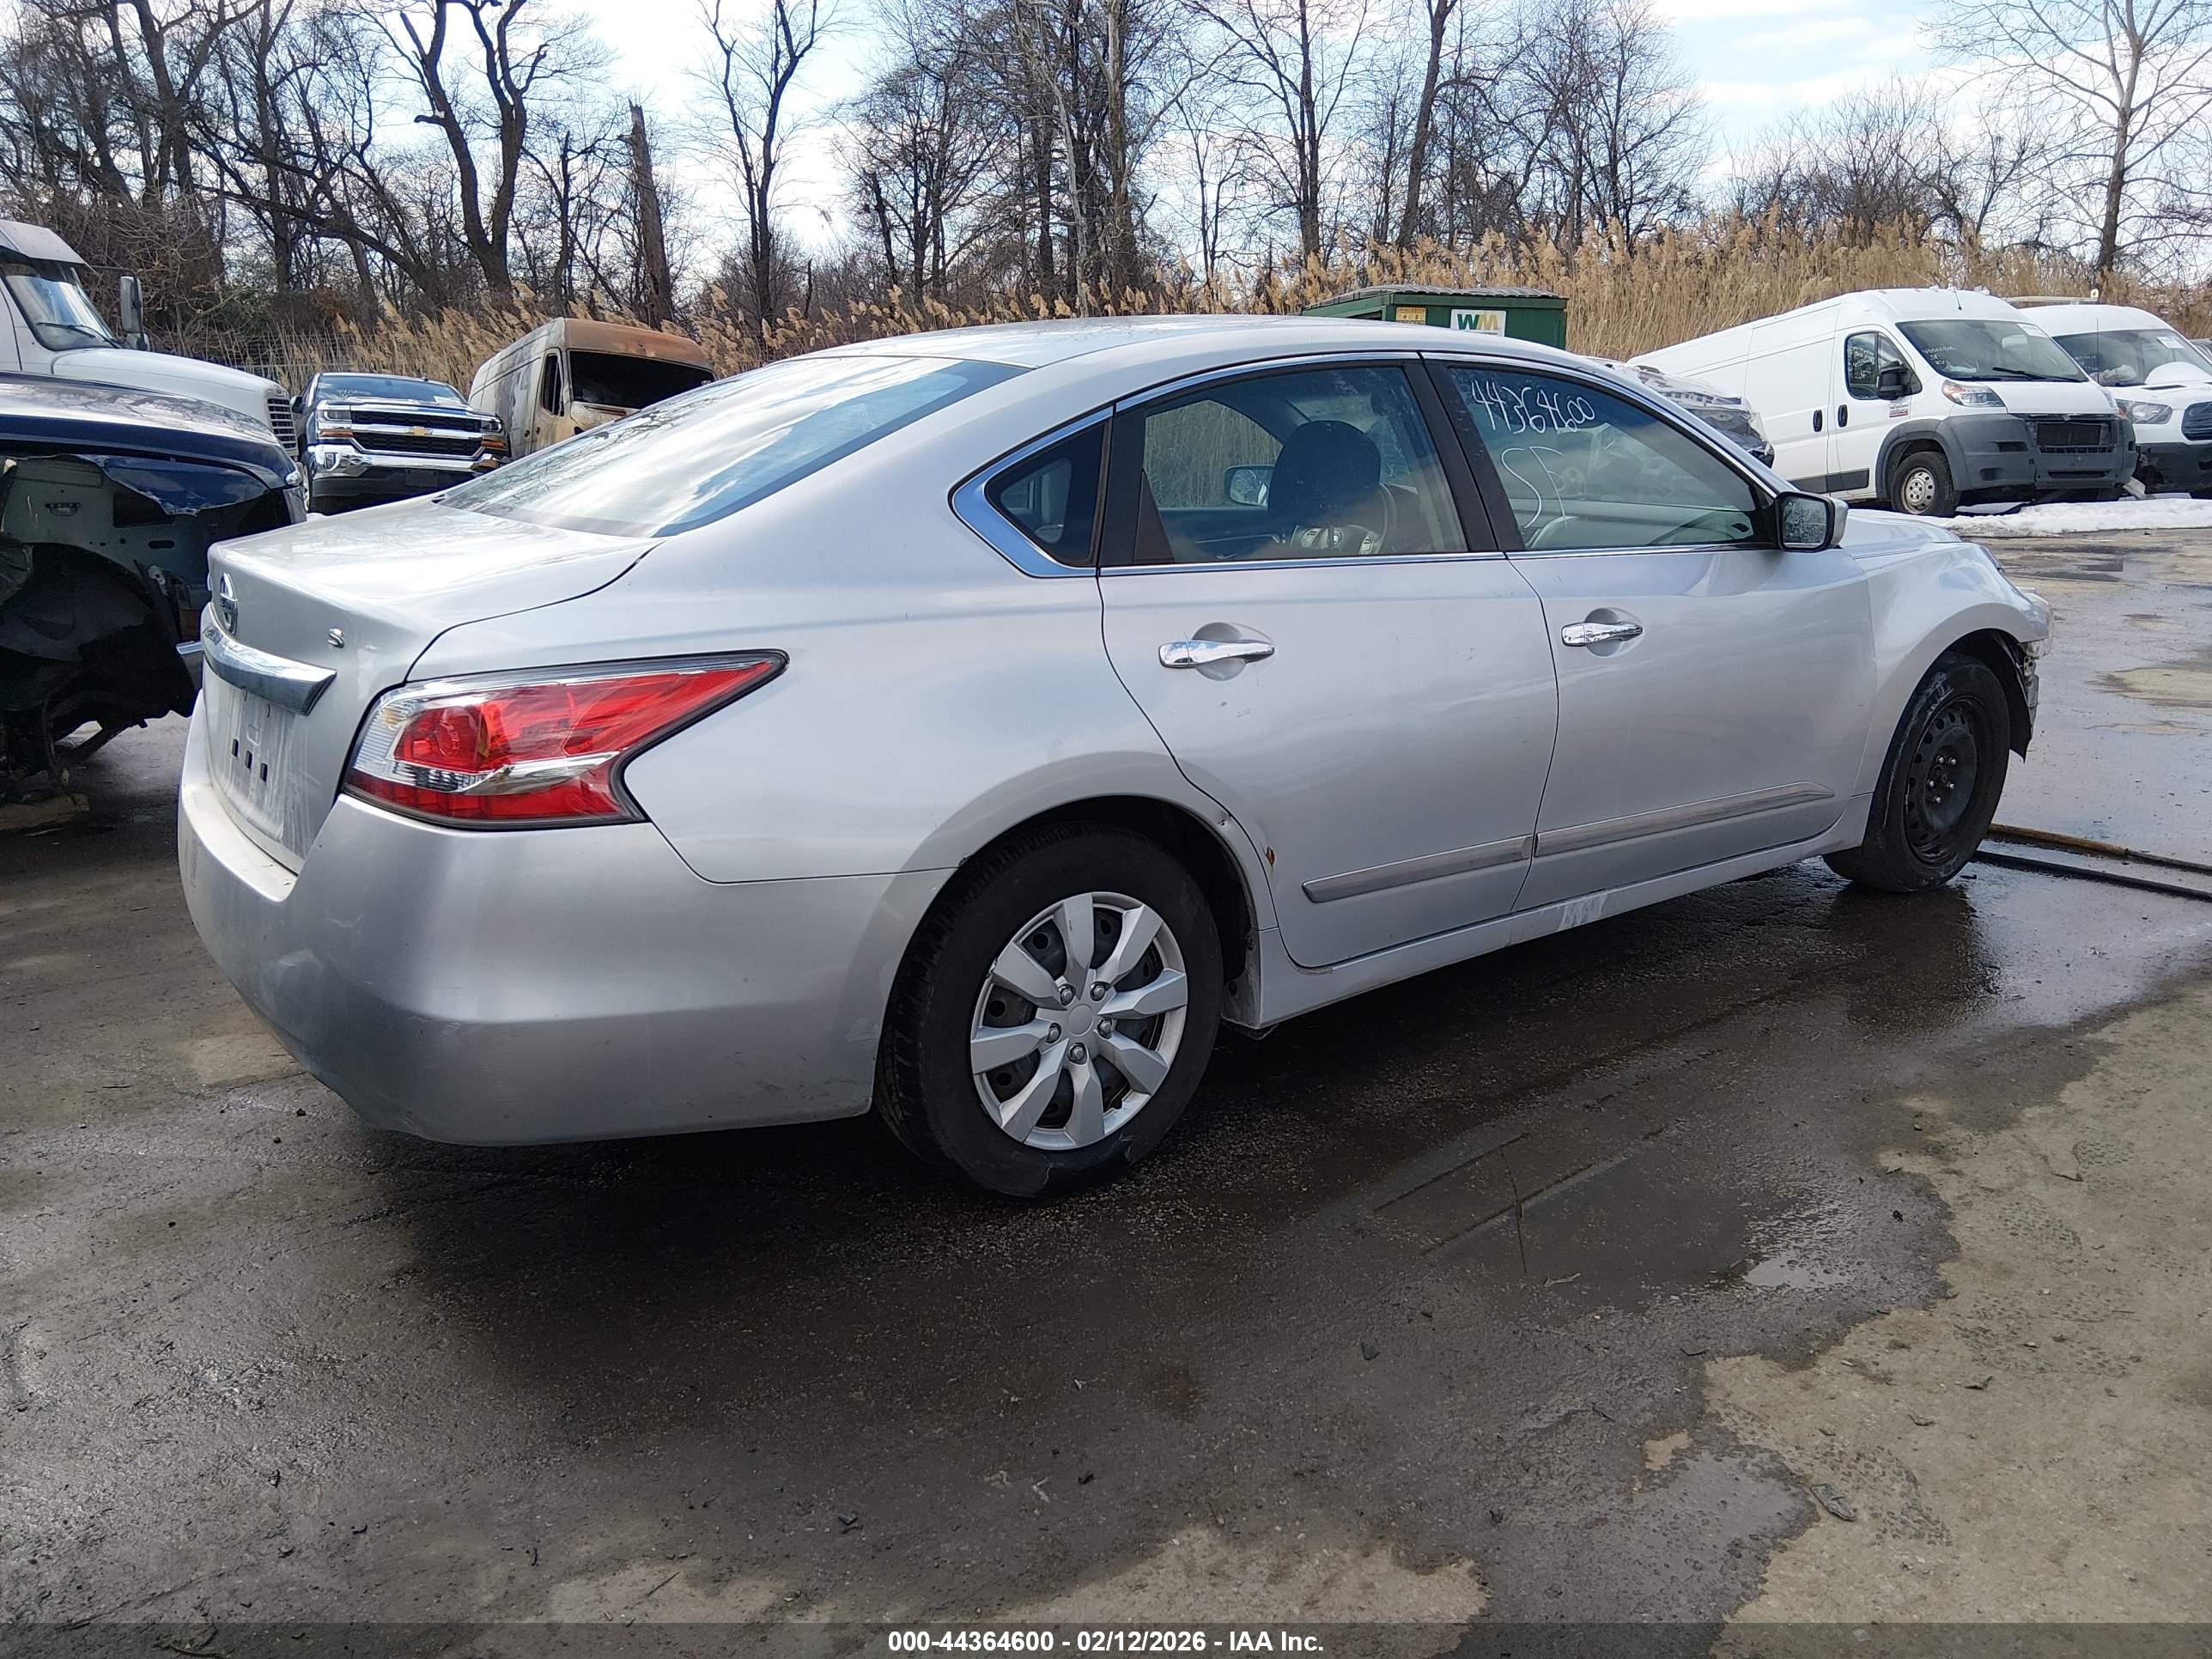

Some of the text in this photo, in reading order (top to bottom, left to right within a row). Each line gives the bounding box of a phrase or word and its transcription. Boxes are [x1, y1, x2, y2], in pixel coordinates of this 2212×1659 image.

[1456, 313, 1498, 331] WM
[1470, 379, 1595, 434] 44364600
[1501, 445, 1568, 529] SF
[328, 628, 344, 648] S
